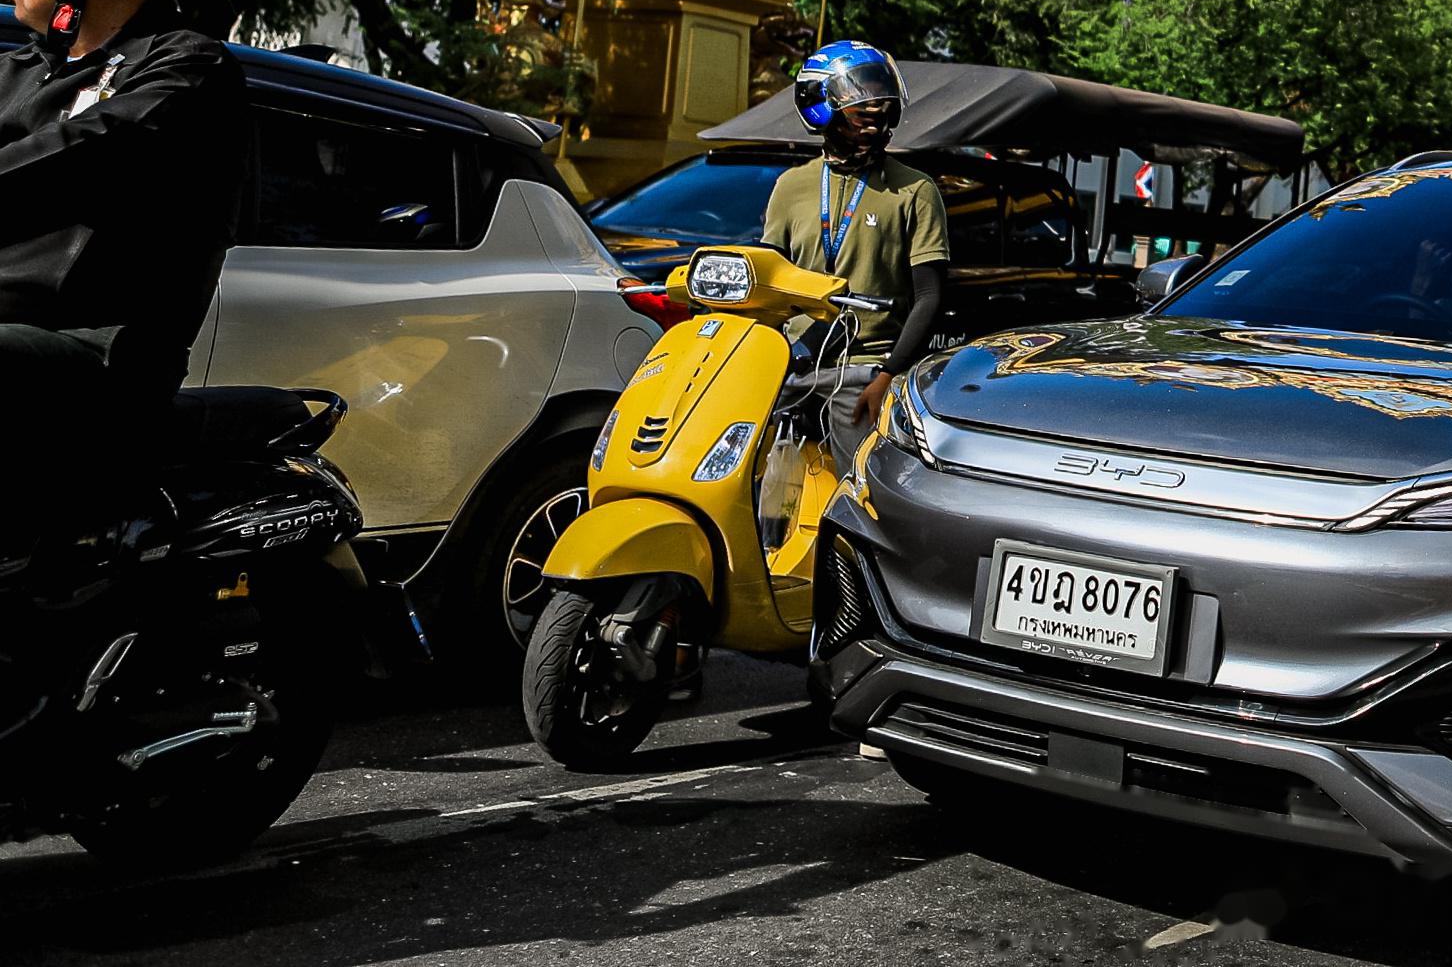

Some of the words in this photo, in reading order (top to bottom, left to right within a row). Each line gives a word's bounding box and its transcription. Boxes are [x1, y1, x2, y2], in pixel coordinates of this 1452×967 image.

[1053, 452, 1186, 489] BYD
[239, 508, 339, 538] SCOOPY
[1082, 575, 1161, 622] 8076
[1017, 615, 1138, 649] กรุงเทพมหานคร
[1021, 640, 1052, 654] BYD
